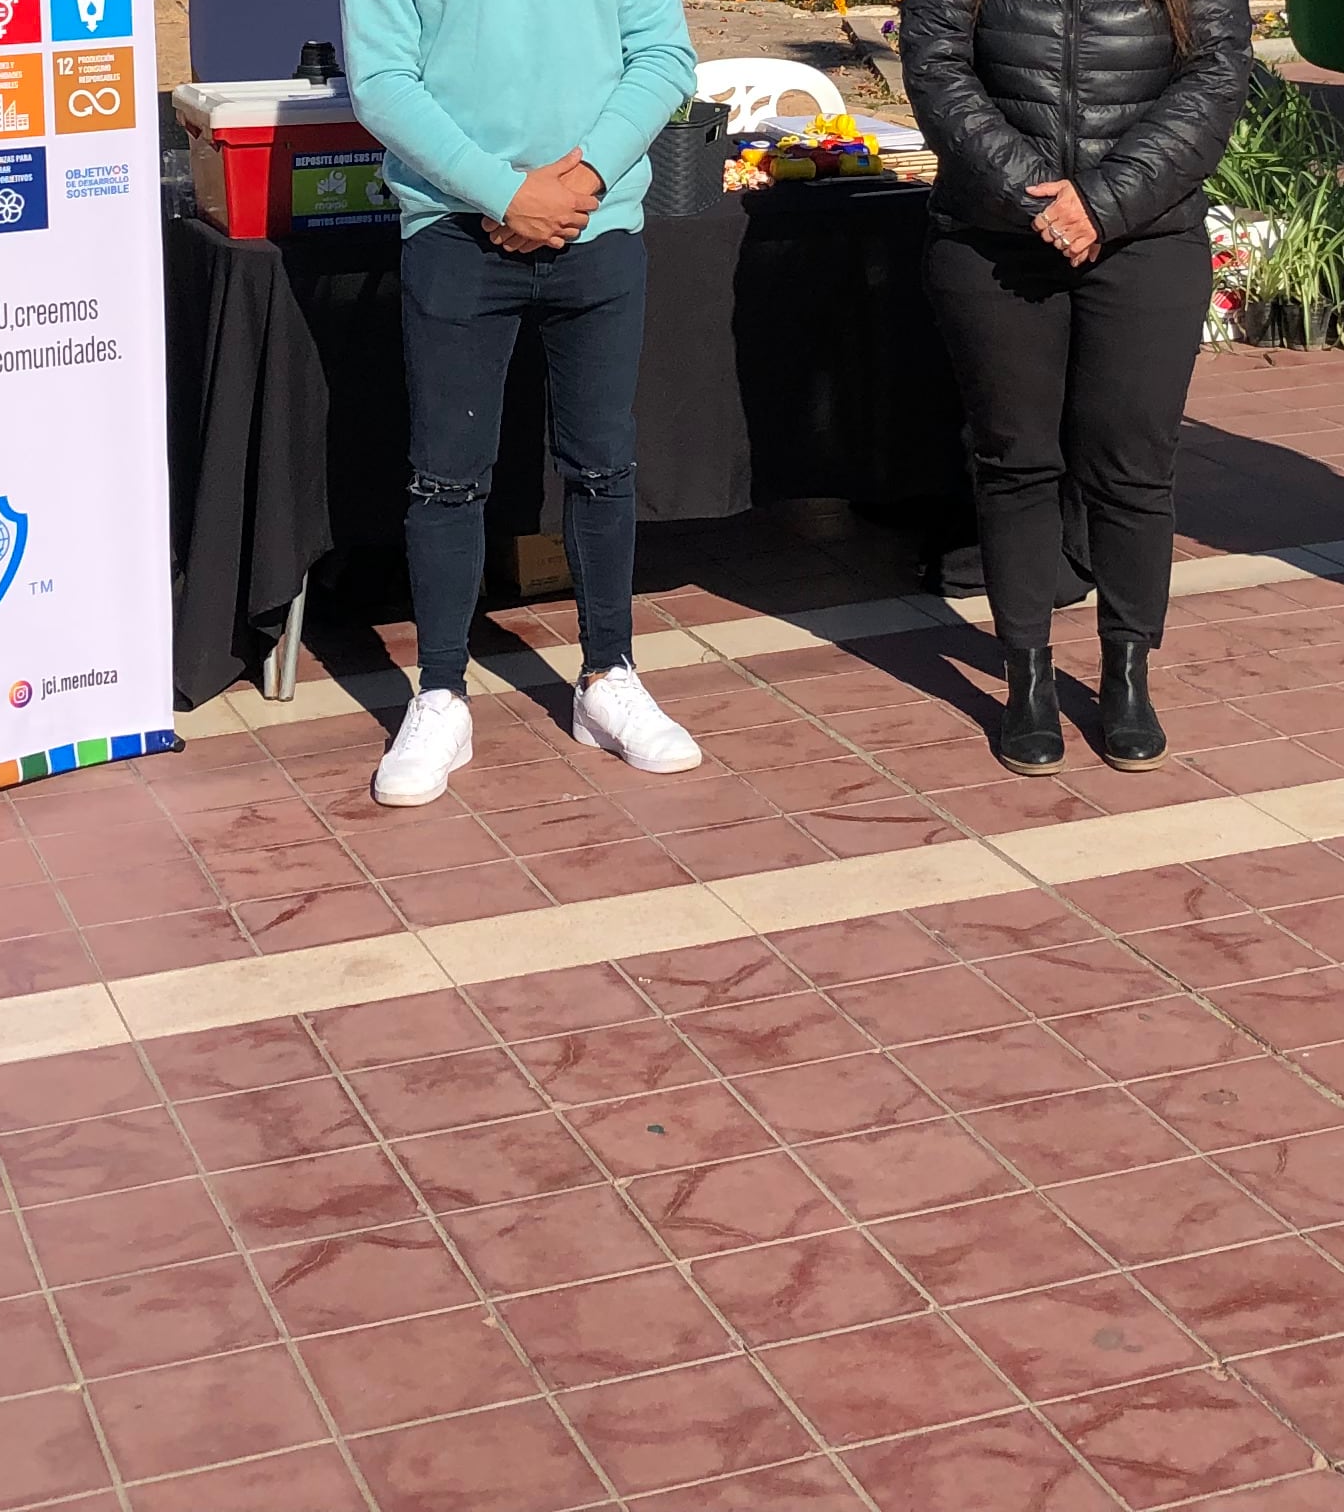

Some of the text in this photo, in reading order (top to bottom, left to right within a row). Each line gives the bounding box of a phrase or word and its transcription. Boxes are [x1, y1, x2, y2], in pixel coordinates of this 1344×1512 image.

[56, 57, 74, 75] 12
[15, 153, 33, 163] PARA
[295, 155, 333, 167] DEPOSITE
[333, 153, 353, 166] AQUÍ
[353, 152, 370, 163] SUS
[0, 173, 33, 185] OBJETIVOS
[65, 164, 130, 180] OBJETIVOS
[65, 175, 130, 189] DE DESARROLLO
[66, 183, 130, 199] SOSTENIBLE
[29, 578, 55, 596] TM
[40, 667, 119, 701] jci.mendoza
